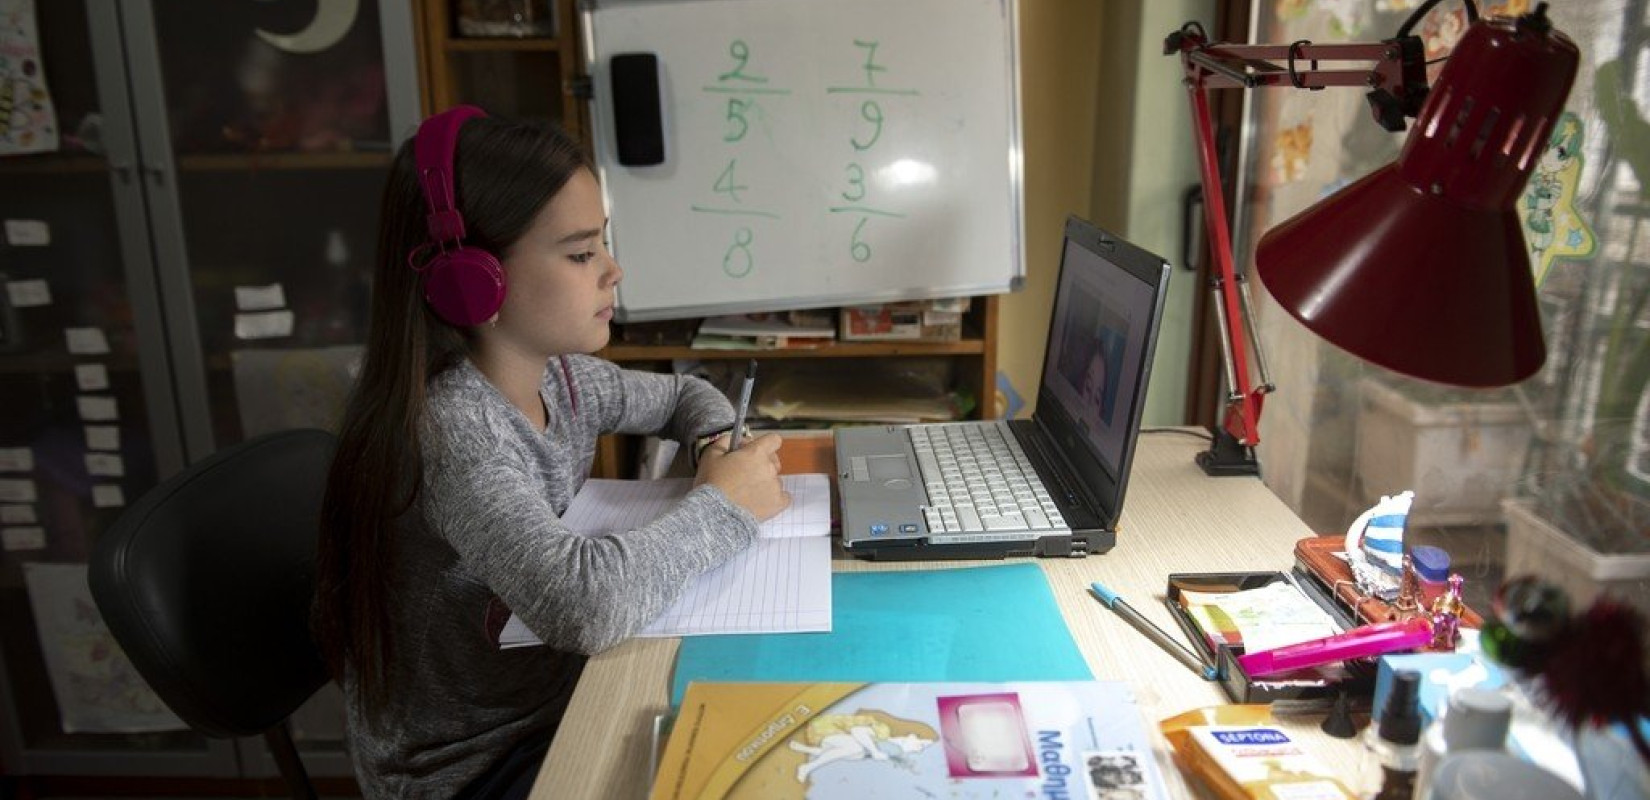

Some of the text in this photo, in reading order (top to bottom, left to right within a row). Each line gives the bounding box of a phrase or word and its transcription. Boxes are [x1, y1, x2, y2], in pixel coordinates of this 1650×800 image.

[718, 40, 769, 83] 2
[853, 40, 887, 86] 7
[724, 98, 748, 142] 5
[850, 100, 884, 151] 9
[712, 159, 749, 201] 4
[841, 162, 866, 202] 3
[723, 227, 753, 279] 8
[850, 217, 871, 263] 6
[1219, 732, 1287, 743] SEPTONA
